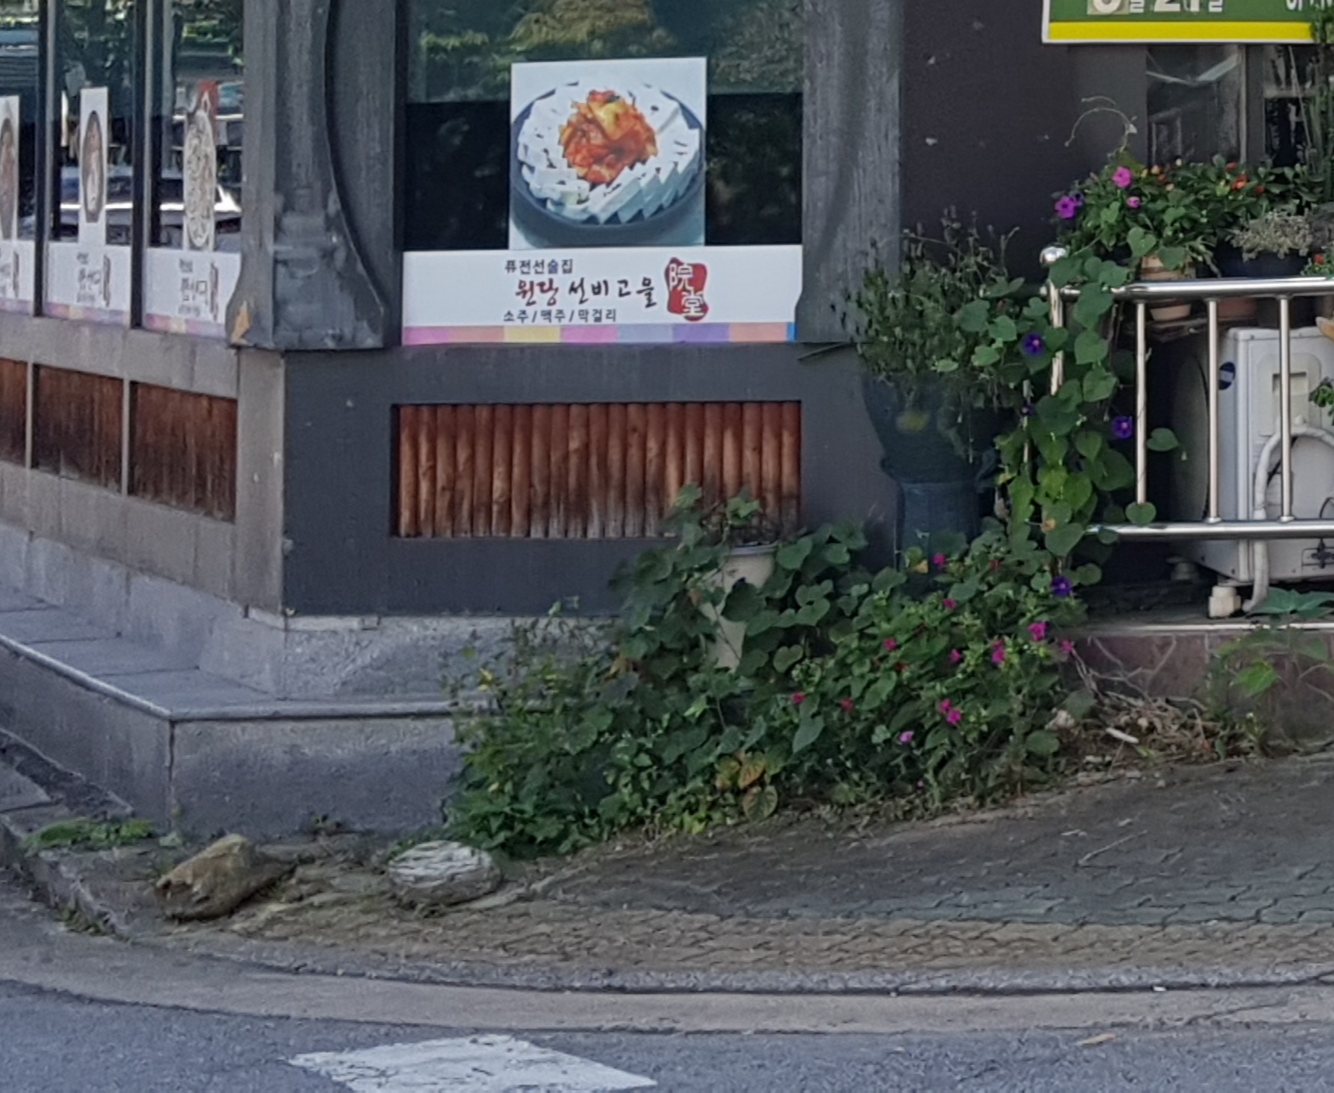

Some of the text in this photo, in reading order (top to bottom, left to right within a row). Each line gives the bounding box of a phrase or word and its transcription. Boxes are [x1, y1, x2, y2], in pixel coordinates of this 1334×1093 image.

[504, 258, 574, 275] 퓨전선술집
[515, 276, 658, 308] 원당 선비고을
